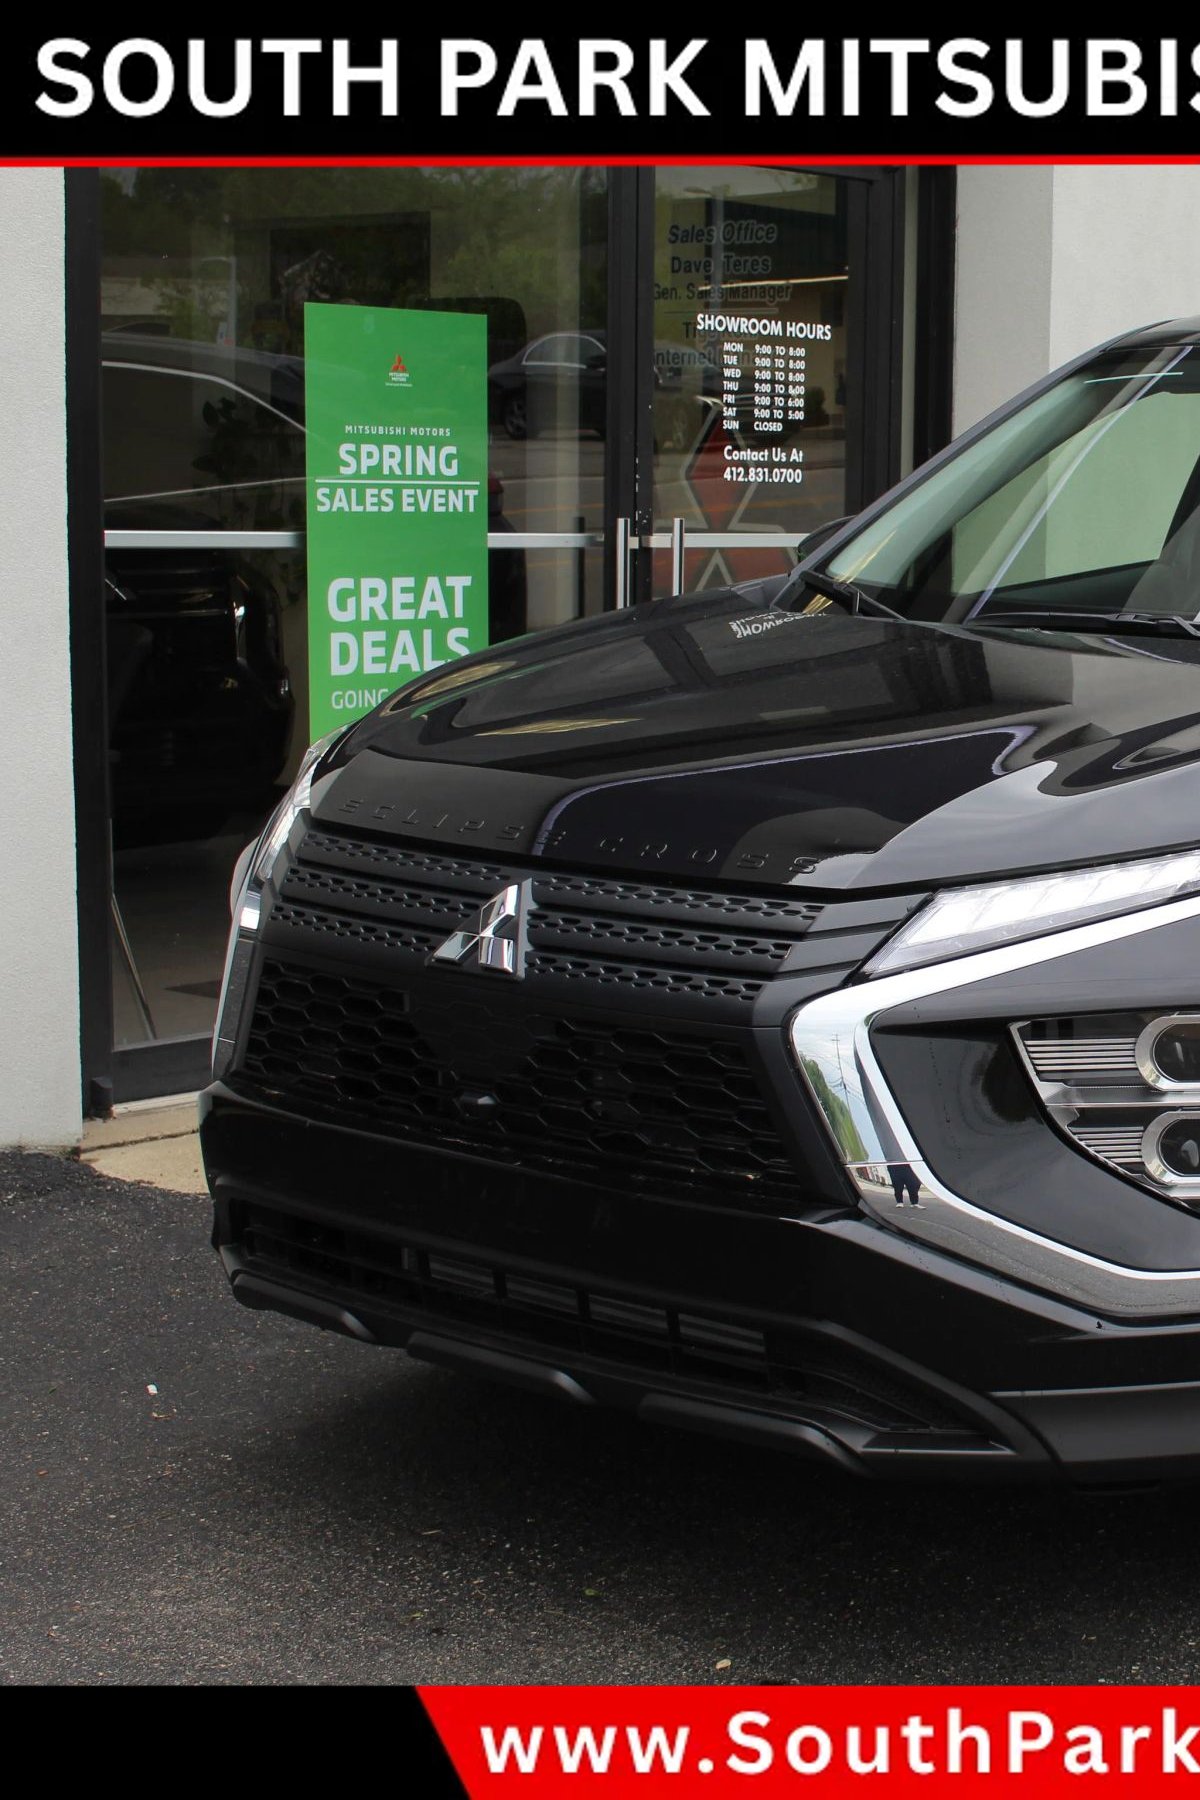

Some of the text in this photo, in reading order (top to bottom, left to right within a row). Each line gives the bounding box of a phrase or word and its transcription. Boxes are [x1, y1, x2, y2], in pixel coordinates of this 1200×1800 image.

[668, 222, 777, 244] Sales Office
[672, 256, 771, 274] Dave Teres
[728, 284, 792, 303] Manager
[697, 314, 782, 336] SHOWROOM
[786, 322, 832, 340] HOURS
[724, 342, 805, 356] MON 9:00 TO 8:00
[654, 350, 711, 367] nternet
[724, 356, 737, 364] TUE
[755, 358, 771, 368] 9:00
[776, 359, 785, 368] TO
[788, 360, 805, 370] 8:00
[724, 369, 804, 382] WED 9:00 TO 8:00
[724, 382, 804, 394] THU 9:00 TO 8:00
[724, 395, 804, 408] FRI 9:00 TO 6:00
[723, 408, 804, 420] SAT 9:00 TO 5:00
[345, 425, 451, 437] MITSUBISHI MOTORS
[723, 421, 782, 431] SUN CLOSED
[339, 443, 458, 476] SPRING
[724, 446, 803, 462] Contact Us At
[724, 468, 802, 483] 412.831.0700
[316, 488, 478, 513] SALES EVENT
[328, 576, 471, 622] GREAT
[331, 628, 470, 676] DEALS
